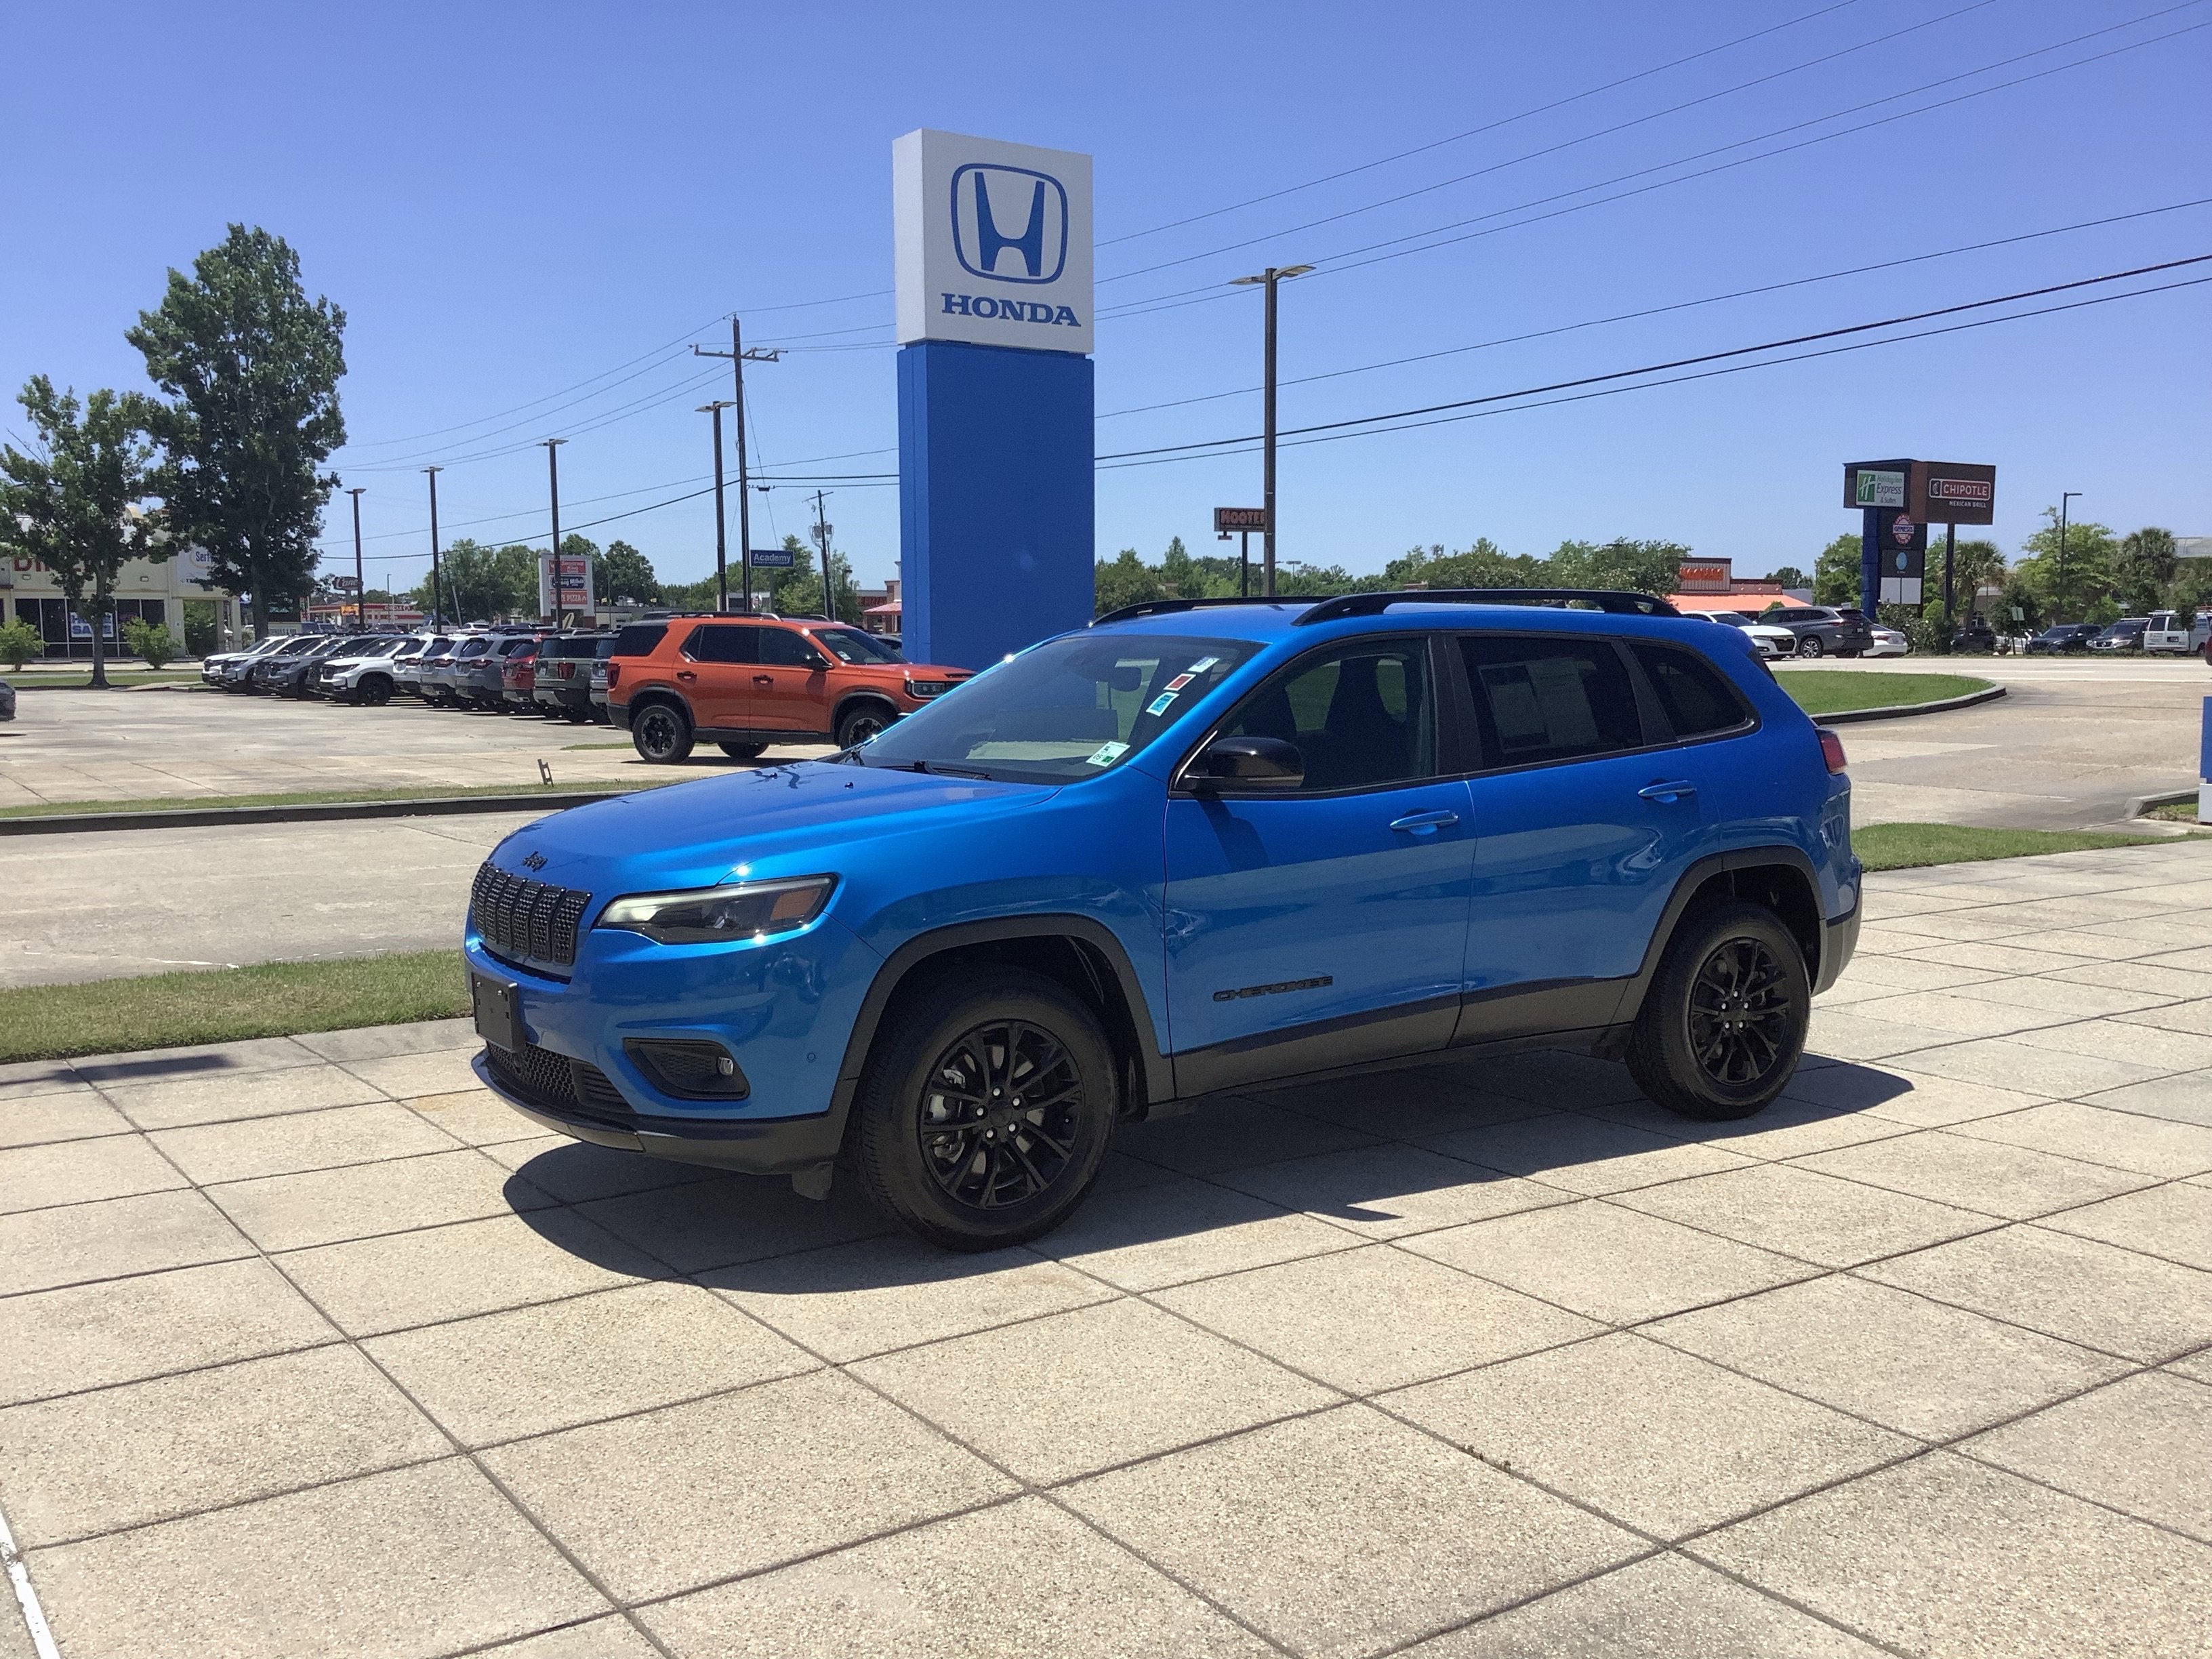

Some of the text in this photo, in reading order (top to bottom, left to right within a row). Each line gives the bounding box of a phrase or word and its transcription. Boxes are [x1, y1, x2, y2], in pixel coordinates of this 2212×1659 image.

[941, 293, 1082, 327] HONDA
[1877, 483, 1902, 497] Express
[1943, 484, 1988, 497] CHIPOTLE
[754, 553, 792, 564] Academy
[73, 625, 112, 634] SAE
